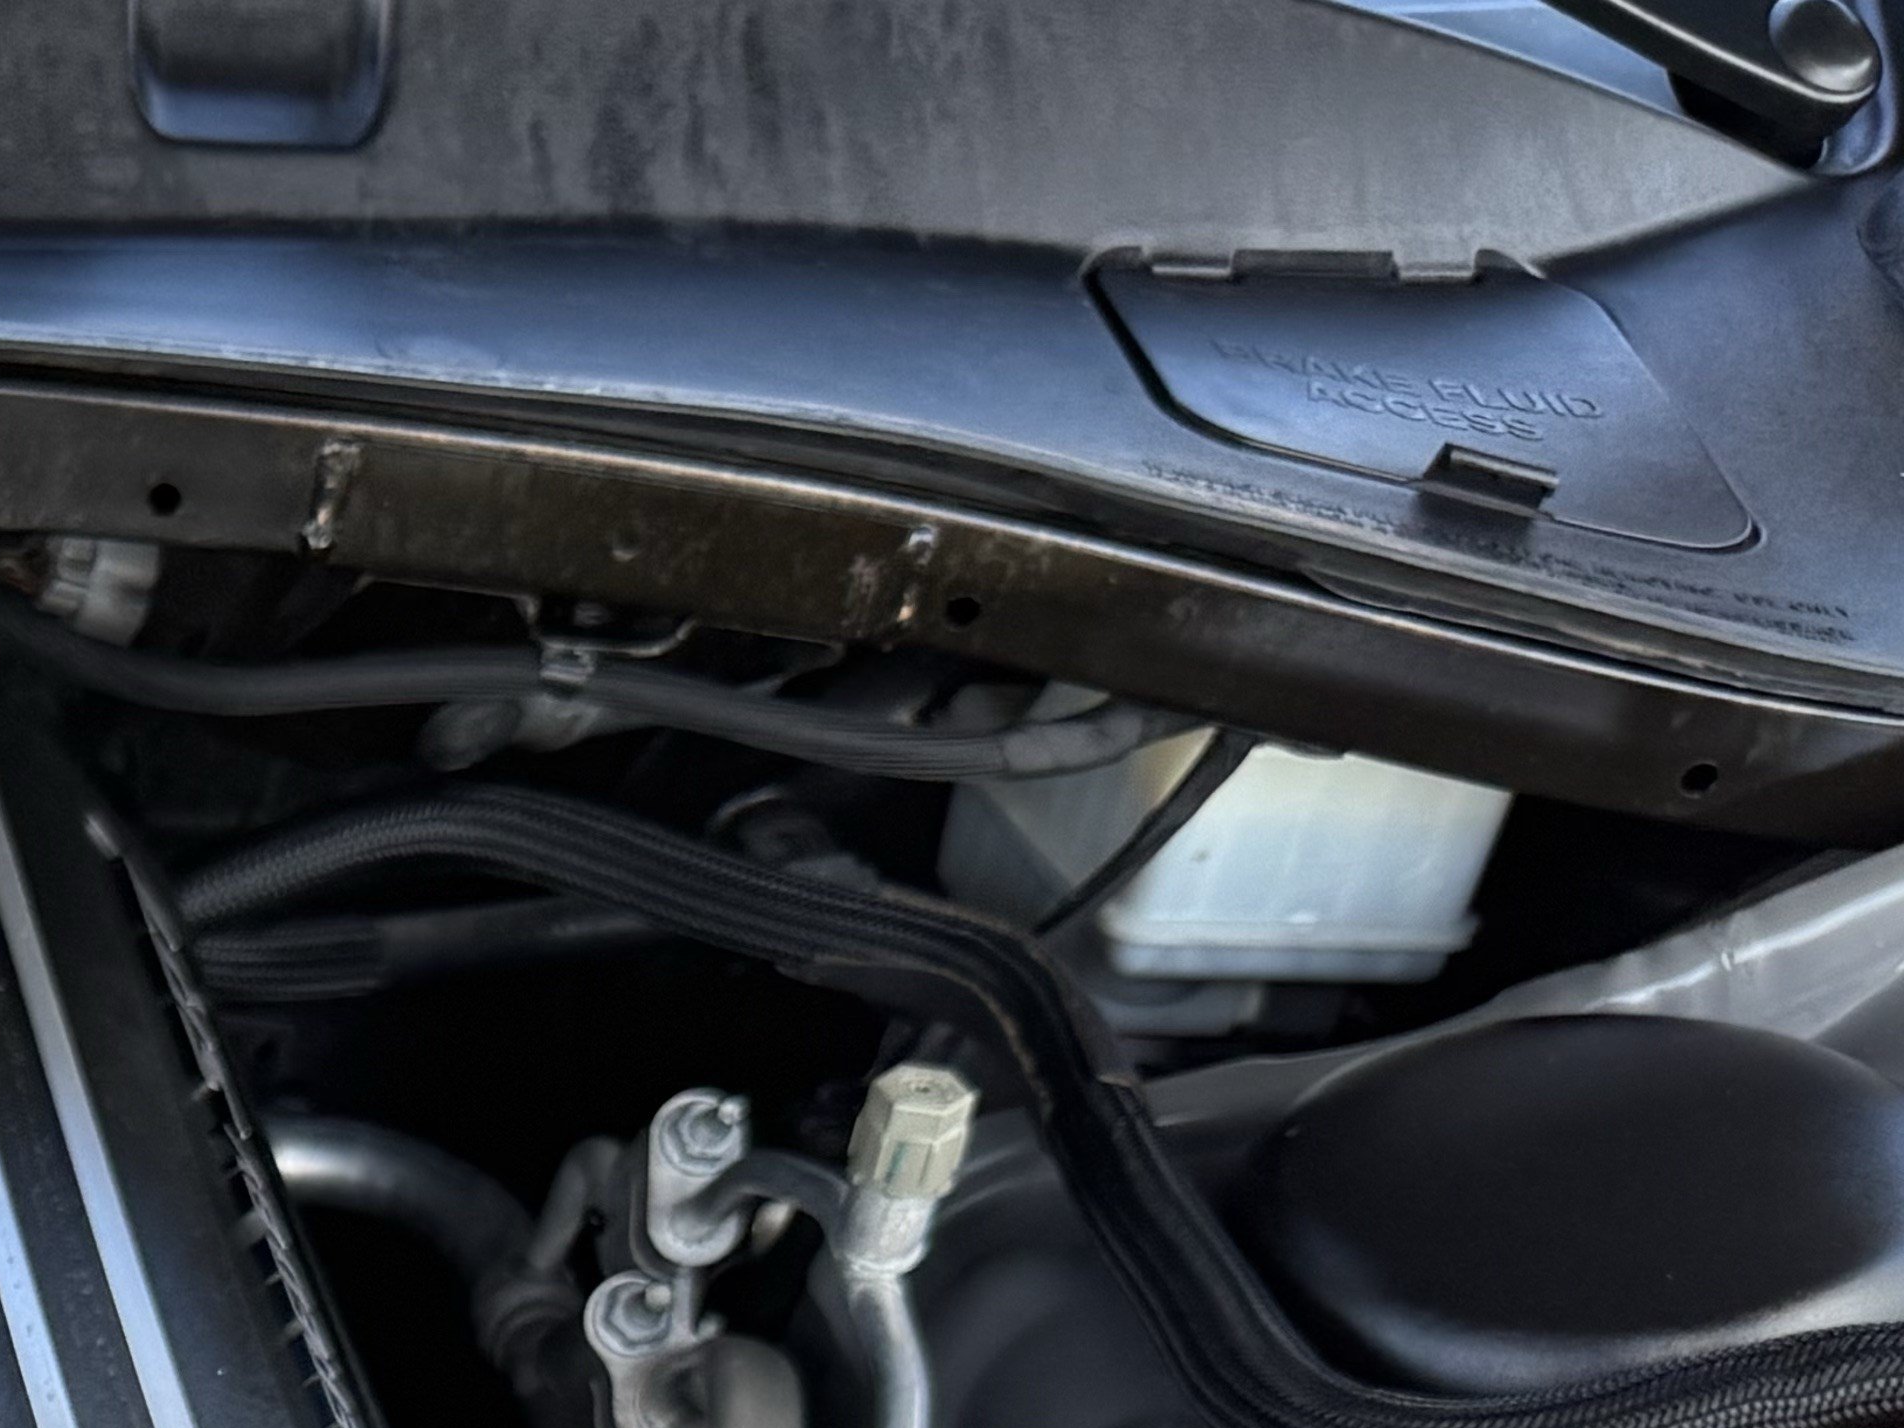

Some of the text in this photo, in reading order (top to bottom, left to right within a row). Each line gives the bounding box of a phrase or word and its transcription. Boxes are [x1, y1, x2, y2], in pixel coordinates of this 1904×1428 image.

[1210, 337, 1604, 421] BRAKE FLUID
[1306, 380, 1546, 442] ACCESS
